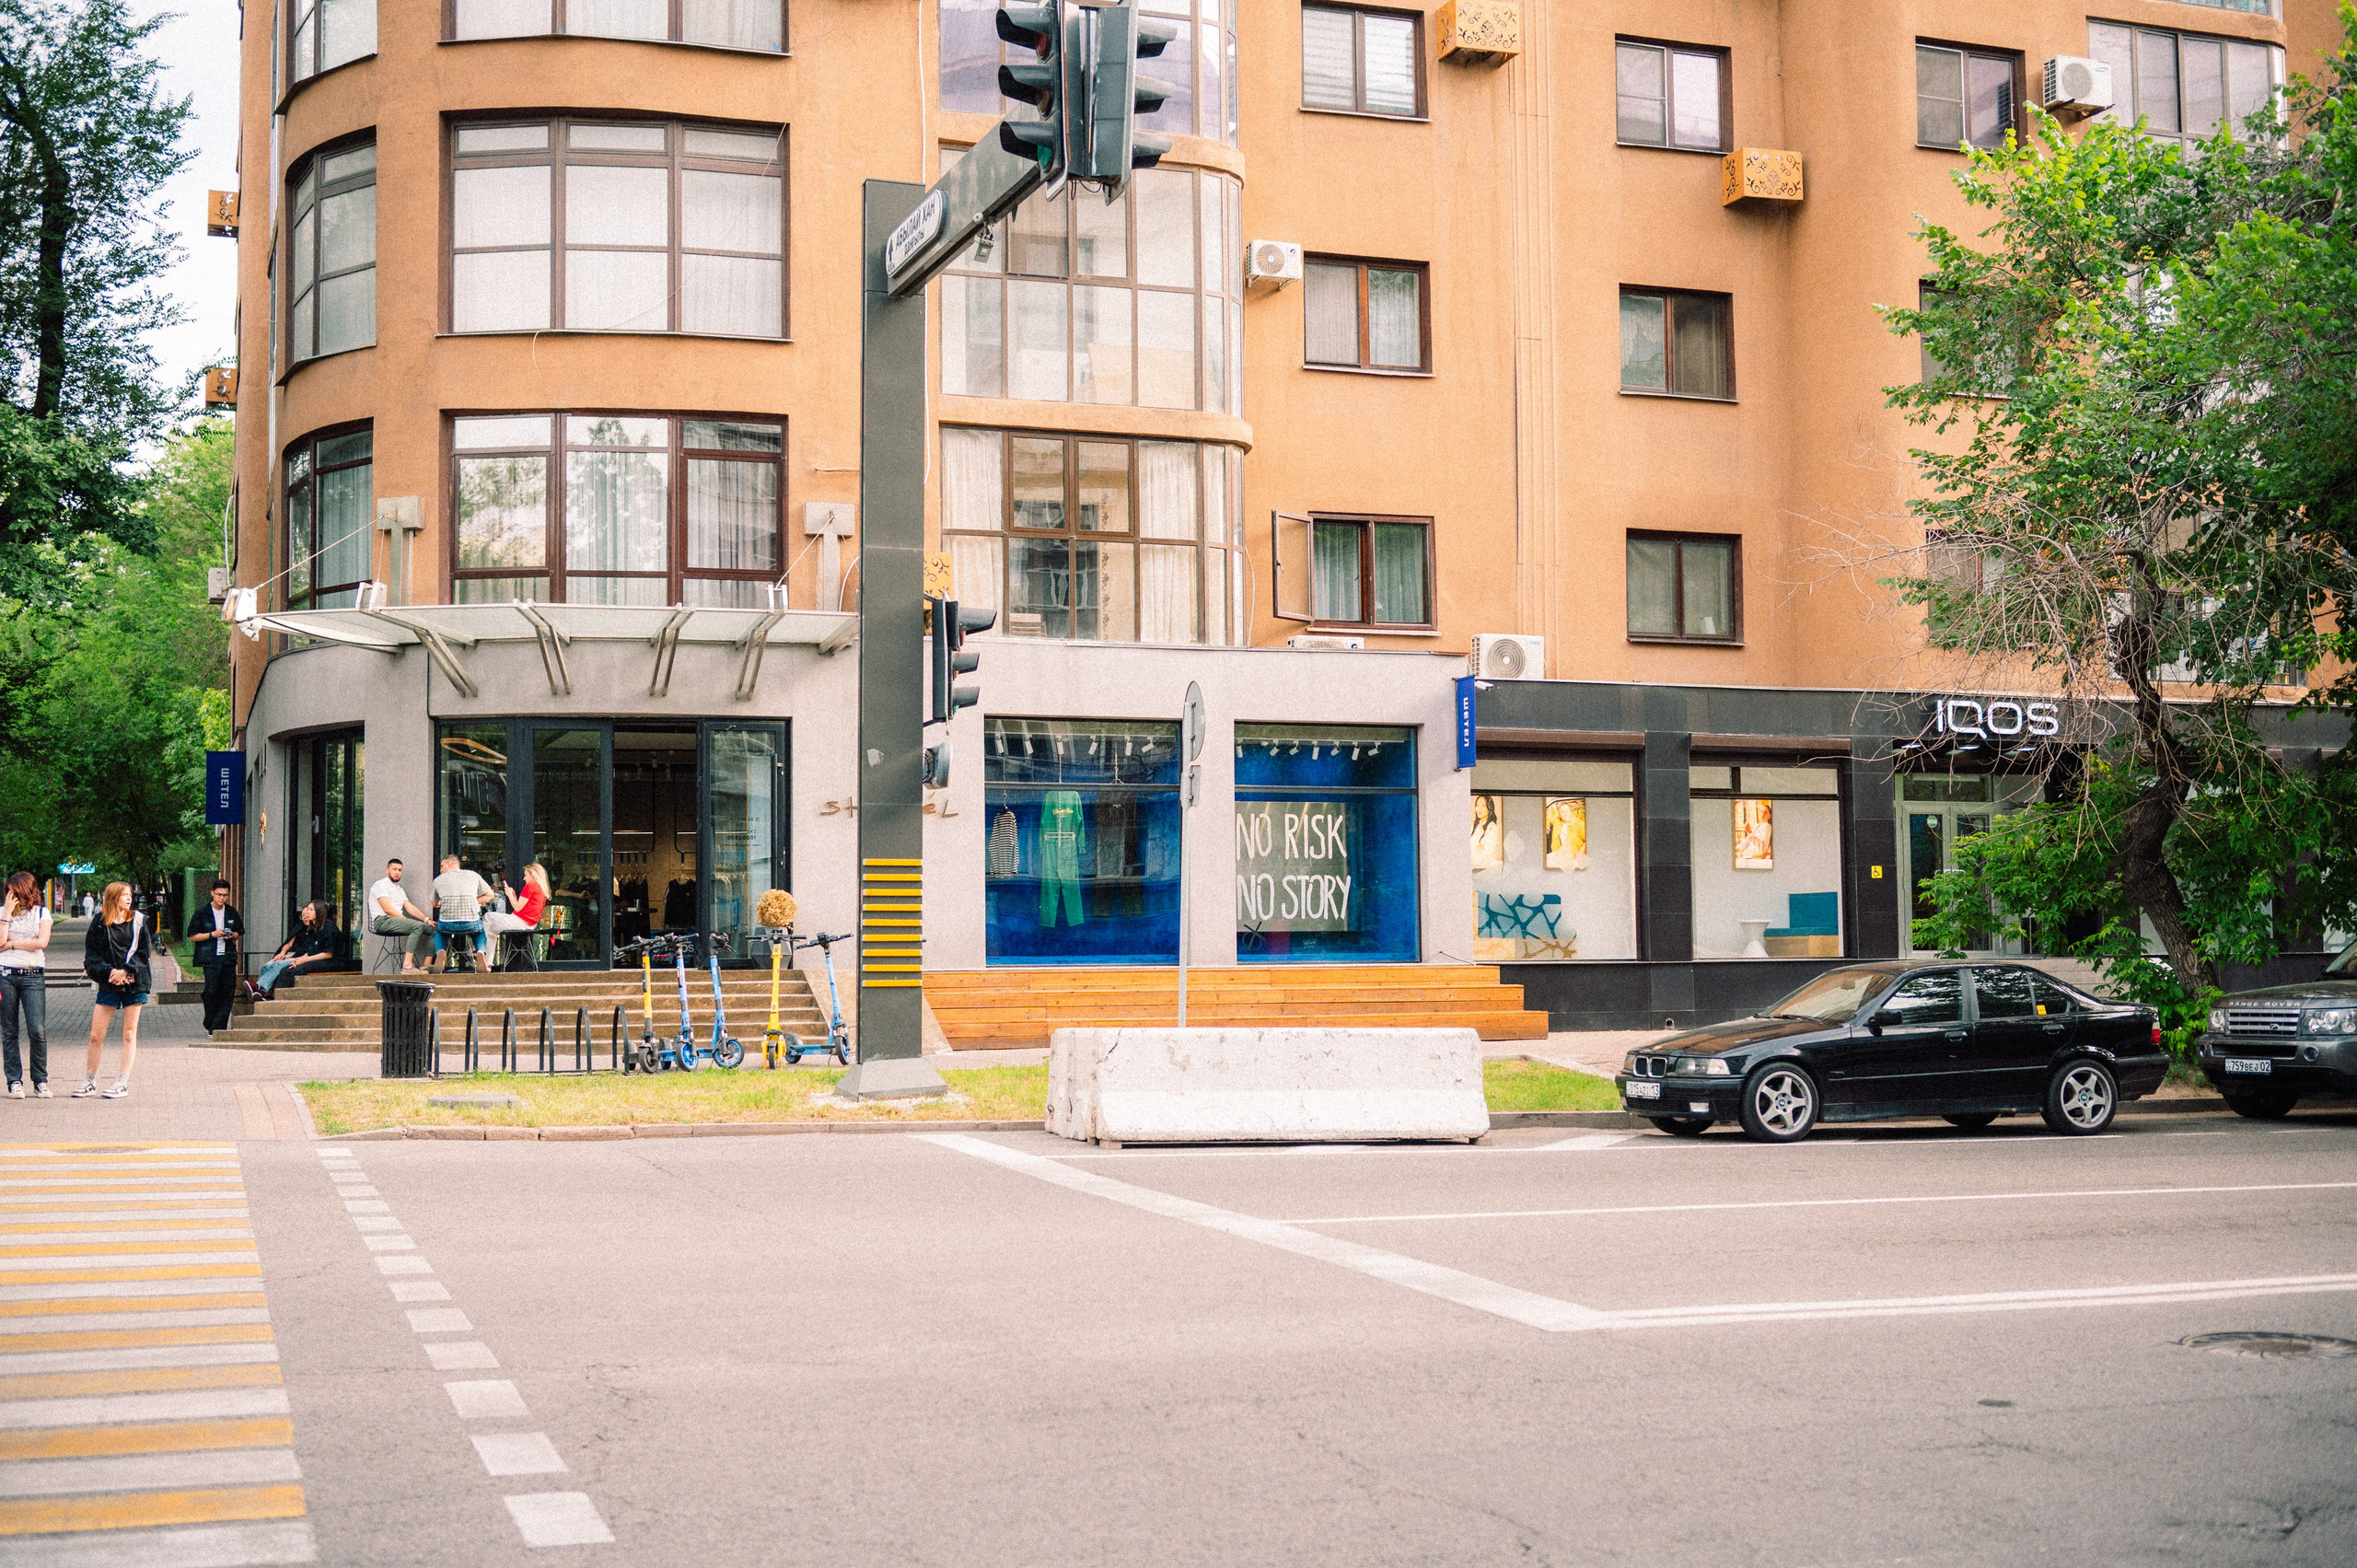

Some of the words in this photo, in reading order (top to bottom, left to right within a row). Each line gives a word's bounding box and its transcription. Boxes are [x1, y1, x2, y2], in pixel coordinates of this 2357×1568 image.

[895, 208, 922, 250] АБЫЛАЙ
[922, 196, 935, 225] ХАН
[1937, 700, 2060, 739] IQOS
[220, 768, 230, 808] ШЕТЕЛ
[1236, 813, 1272, 861] NO
[1284, 814, 1347, 860] RISK
[1237, 873, 1275, 921] NO
[1282, 874, 1352, 921] STORY
